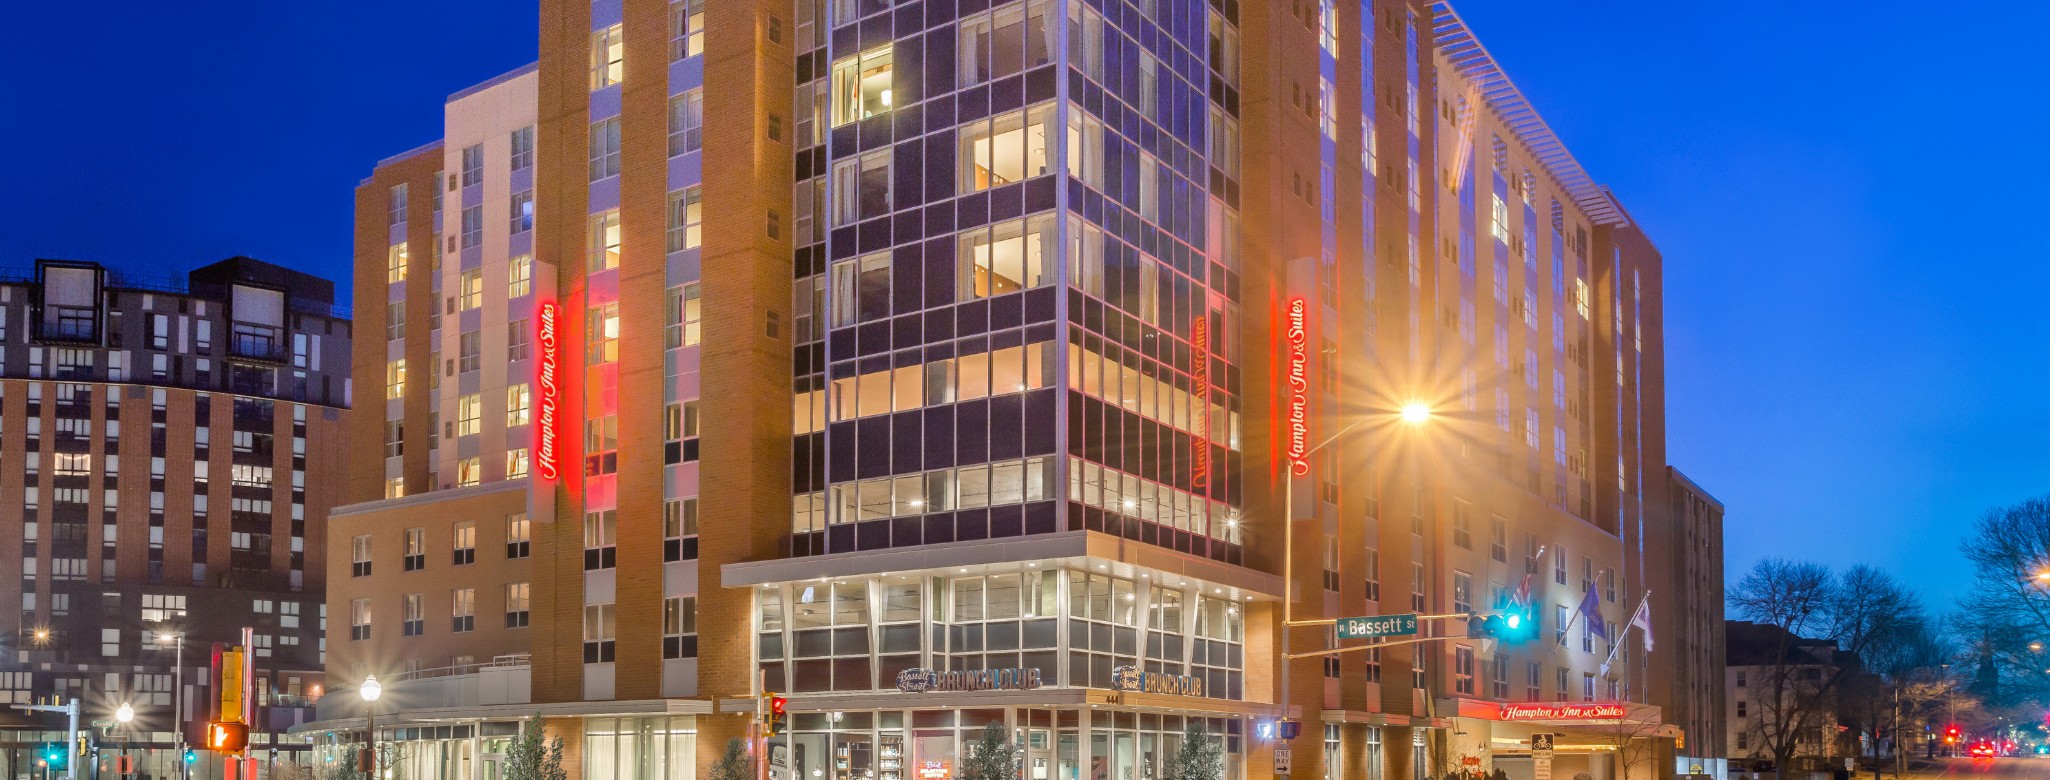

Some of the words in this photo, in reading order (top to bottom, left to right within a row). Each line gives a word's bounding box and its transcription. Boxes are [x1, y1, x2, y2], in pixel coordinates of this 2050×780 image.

[540, 303, 555, 348] Suites
[1288, 299, 1305, 343] Suites
[540, 355, 556, 397] Inn
[1289, 351, 1307, 393] Inn
[538, 397, 556, 478] Hampton
[1339, 624, 1345, 633] N
[1348, 617, 1402, 635] Bassett
[1406, 620, 1415, 629] St
[897, 671, 930, 682] Bassett
[898, 680, 928, 693] Street
[936, 670, 996, 691] BRUNCH
[1000, 668, 1037, 690] CLUB
[1144, 672, 1179, 694] BRUNCH
[1181, 675, 1202, 696] CLUB
[1500, 706, 1559, 720] Hampton
[1557, 706, 1587, 719] Inn
[1590, 705, 1624, 717] Suites
[1276, 750, 1289, 758] ONE
